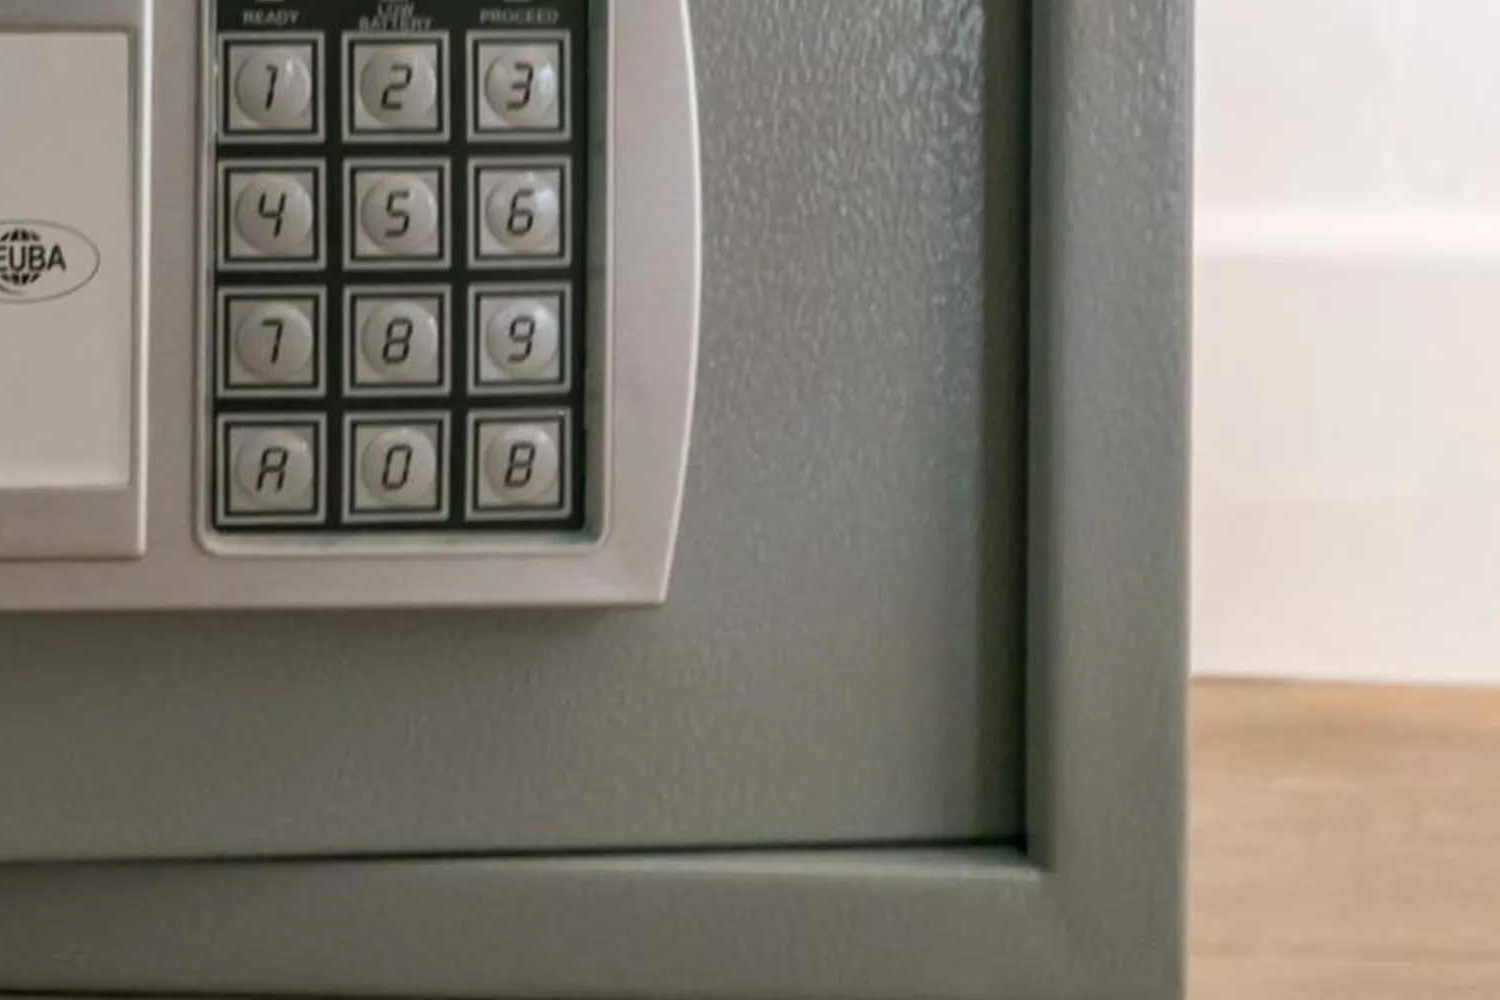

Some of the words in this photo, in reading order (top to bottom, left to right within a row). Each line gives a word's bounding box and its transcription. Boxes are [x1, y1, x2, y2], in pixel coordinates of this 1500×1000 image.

[243, 8, 300, 25] READY
[358, 16, 433, 31] BATTERY
[377, 1, 415, 16] LOW
[479, 8, 560, 24] PROCEED
[264, 63, 279, 111] 1
[379, 63, 413, 111] 2
[505, 61, 534, 110] 3
[258, 191, 287, 239] 4
[384, 189, 412, 239] 5
[505, 188, 535, 236] 6
[261, 318, 285, 365] 7
[381, 316, 414, 365] 8
[506, 315, 536, 363] 9
